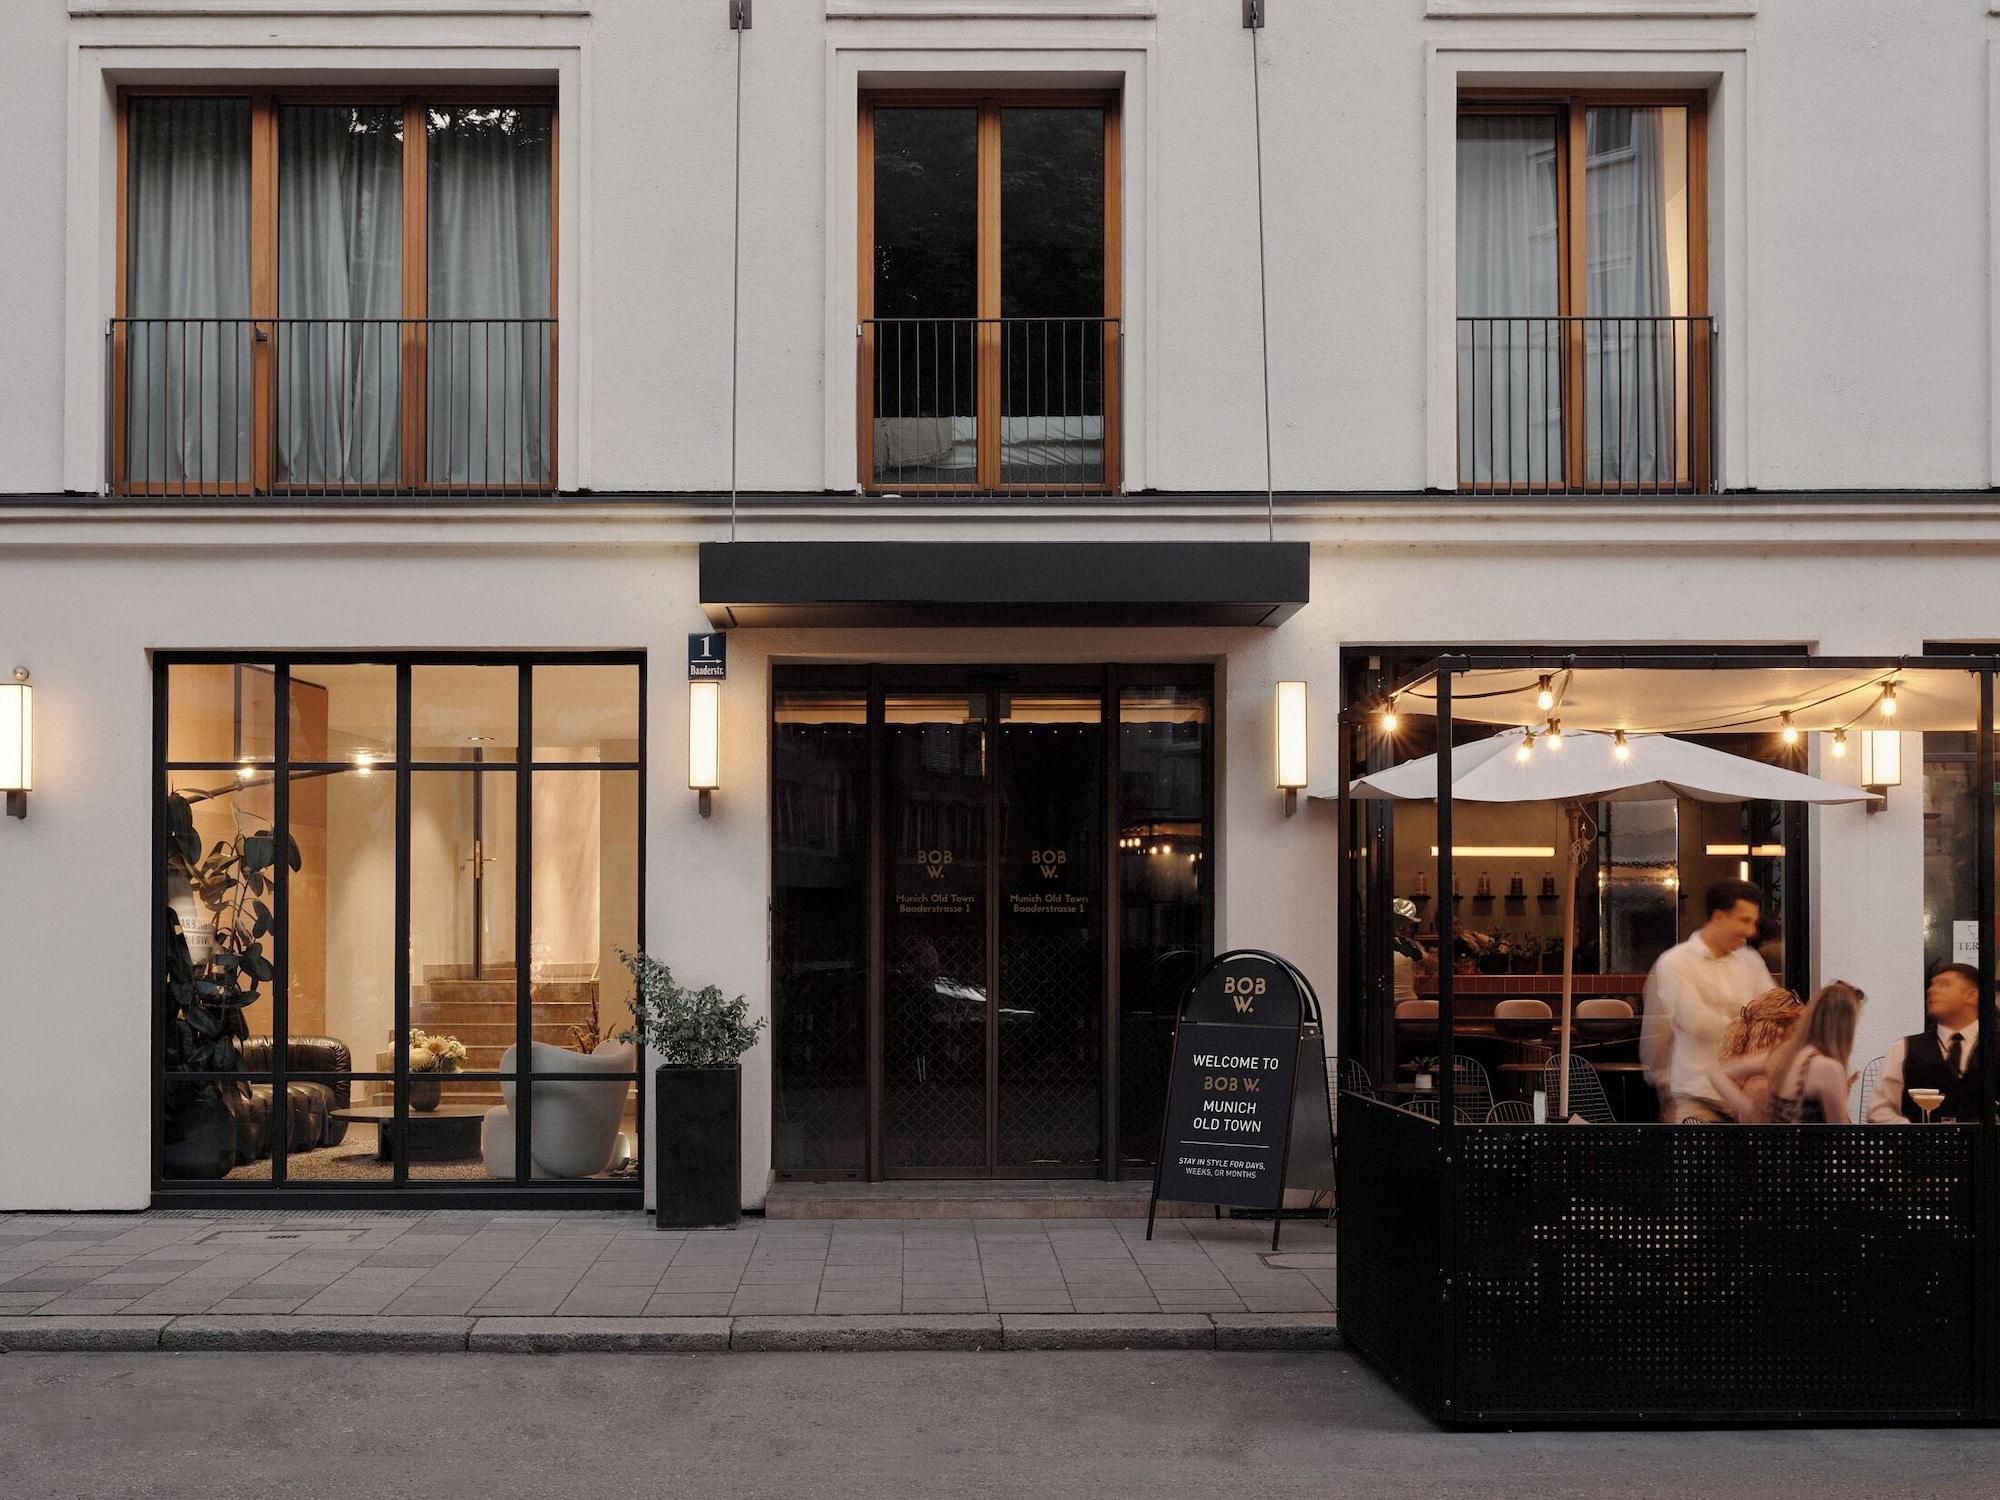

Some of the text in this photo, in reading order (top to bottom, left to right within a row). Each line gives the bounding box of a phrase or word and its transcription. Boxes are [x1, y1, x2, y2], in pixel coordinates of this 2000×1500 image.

[700, 635, 712, 657] 1
[690, 665, 724, 676] Baaderstr.
[917, 850, 953, 864] BOB
[1032, 850, 1067, 864] BOB
[926, 865, 945, 879] W.
[1040, 865, 1059, 879] W.
[896, 893, 975, 903] Munich Old Town
[1010, 893, 1088, 903] Munich Old Town
[899, 903, 970, 913] Baaderstrasse 1
[1013, 903, 1085, 913] Baaderstrasse 1
[1224, 976, 1267, 995] BOB
[1233, 995, 1254, 1013] W.
[1193, 1054, 1279, 1070] WELCOME TO
[1203, 1076, 1260, 1092] BOB W.
[1203, 1100, 1256, 1114] MUNICH
[1193, 1117, 1262, 1132] OLD TOWN
[1178, 1157, 1266, 1171] STAY IN STYLE FOR DAYS,
[1185, 1167, 1257, 1179] WEEKS, OR MONTHS
